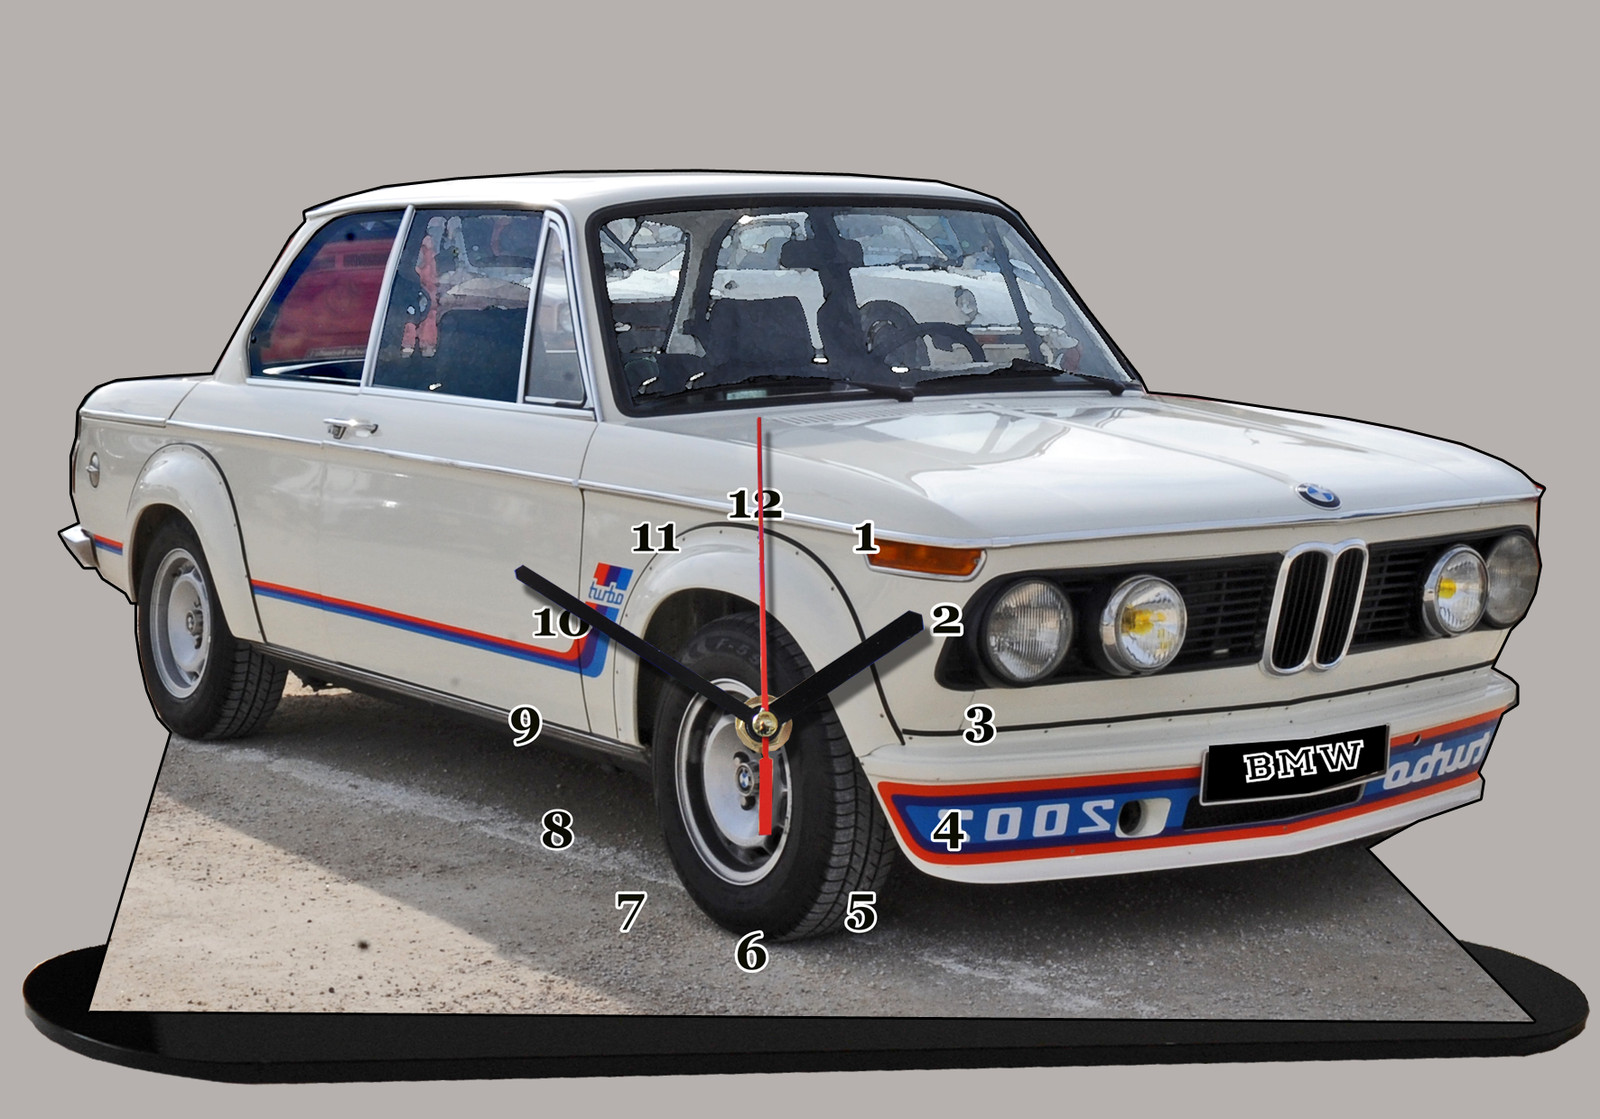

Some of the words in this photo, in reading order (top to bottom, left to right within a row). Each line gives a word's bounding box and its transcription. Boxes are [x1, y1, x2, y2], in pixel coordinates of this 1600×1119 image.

[727, 488, 784, 521] 12
[631, 521, 681, 554] 11
[850, 520, 880, 554] 1
[588, 580, 625, 606] turbo
[533, 606, 593, 640] 10
[930, 603, 964, 637] 2
[508, 704, 543, 747] 9
[962, 703, 997, 746] 3
[1243, 739, 1365, 784] BMW
[540, 809, 575, 851] 8
[930, 809, 967, 852] 4
[615, 891, 648, 933] 7
[844, 891, 877, 933] 5
[734, 930, 769, 973] 6
